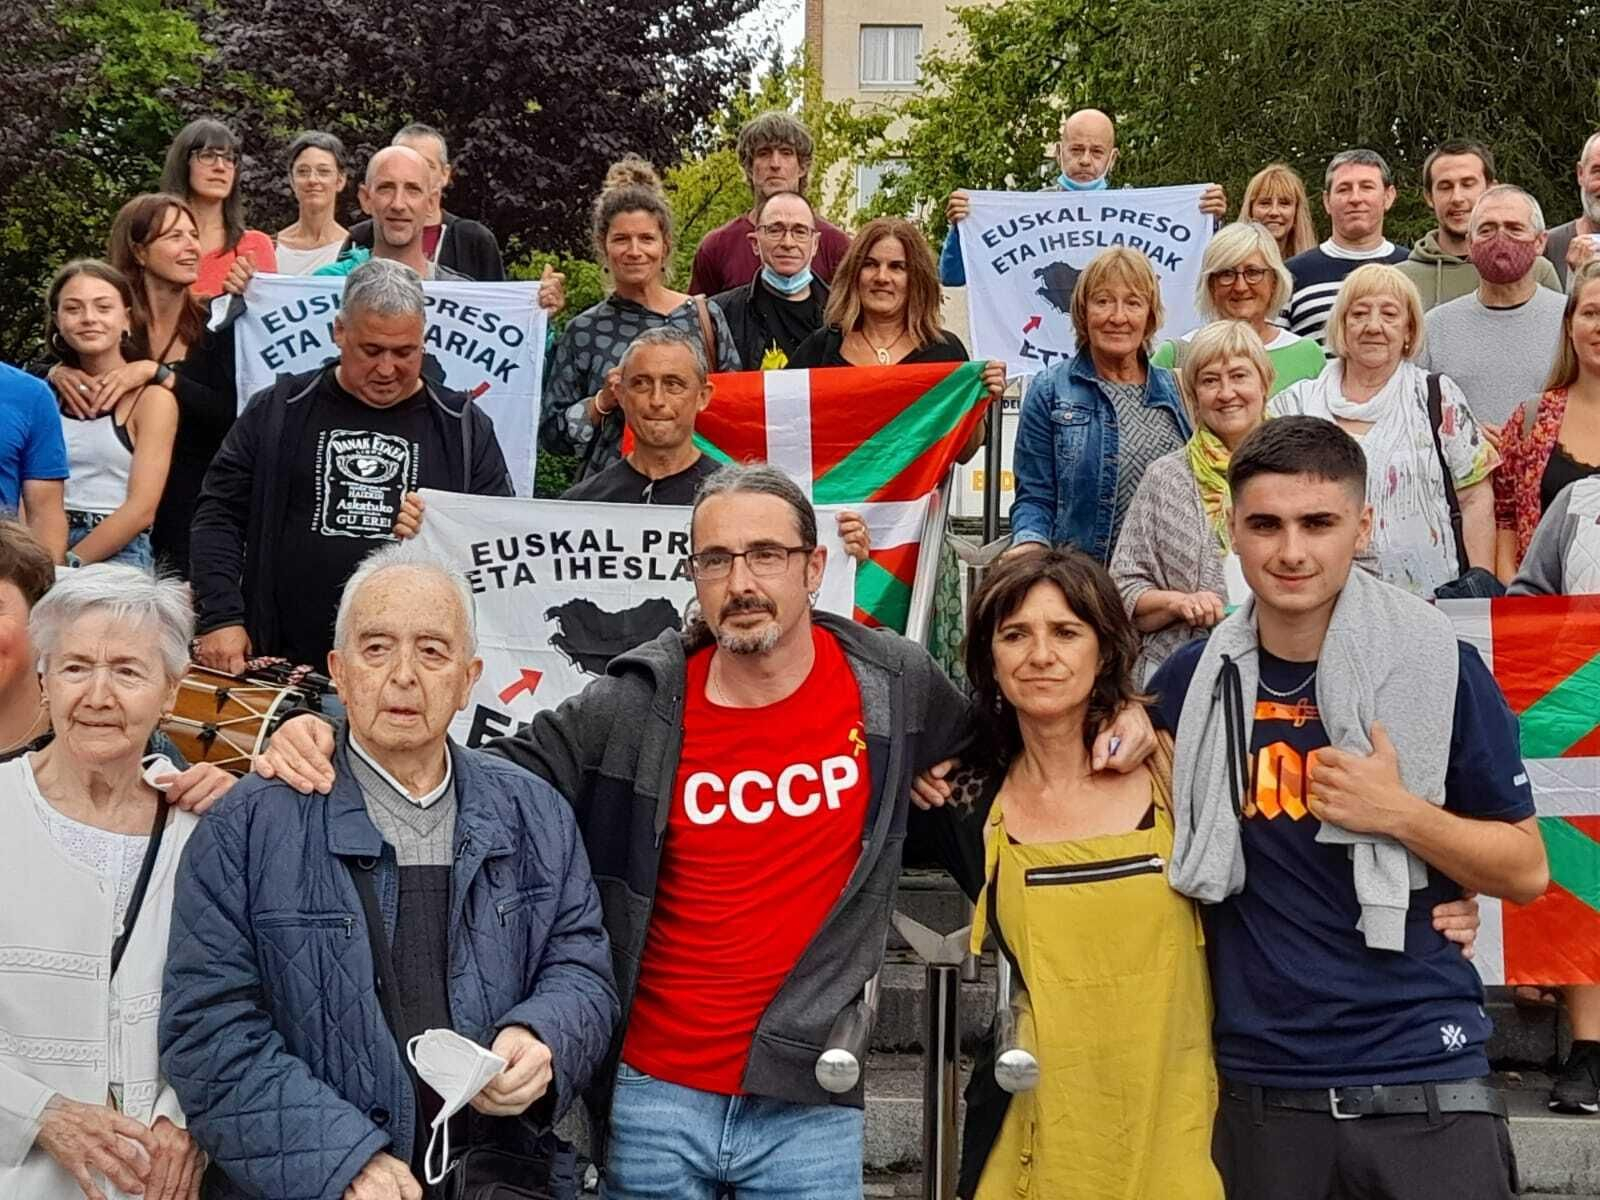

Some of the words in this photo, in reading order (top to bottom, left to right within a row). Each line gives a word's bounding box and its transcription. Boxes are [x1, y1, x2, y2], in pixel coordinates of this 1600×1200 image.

[982, 207, 1092, 249] EUSKAL
[1100, 206, 1191, 243] PRESO
[991, 243, 1037, 275] ETA
[1040, 230, 1183, 272] IHESLARIAK
[259, 329, 321, 370] ETA
[336, 499, 393, 514] Askatuko
[336, 514, 357, 525] GU
[471, 529, 624, 566] EUSKAL
[642, 530, 690, 555] PR
[464, 562, 536, 594] ETA
[554, 556, 692, 582] IHESLA
[684, 755, 859, 825] CCCP
